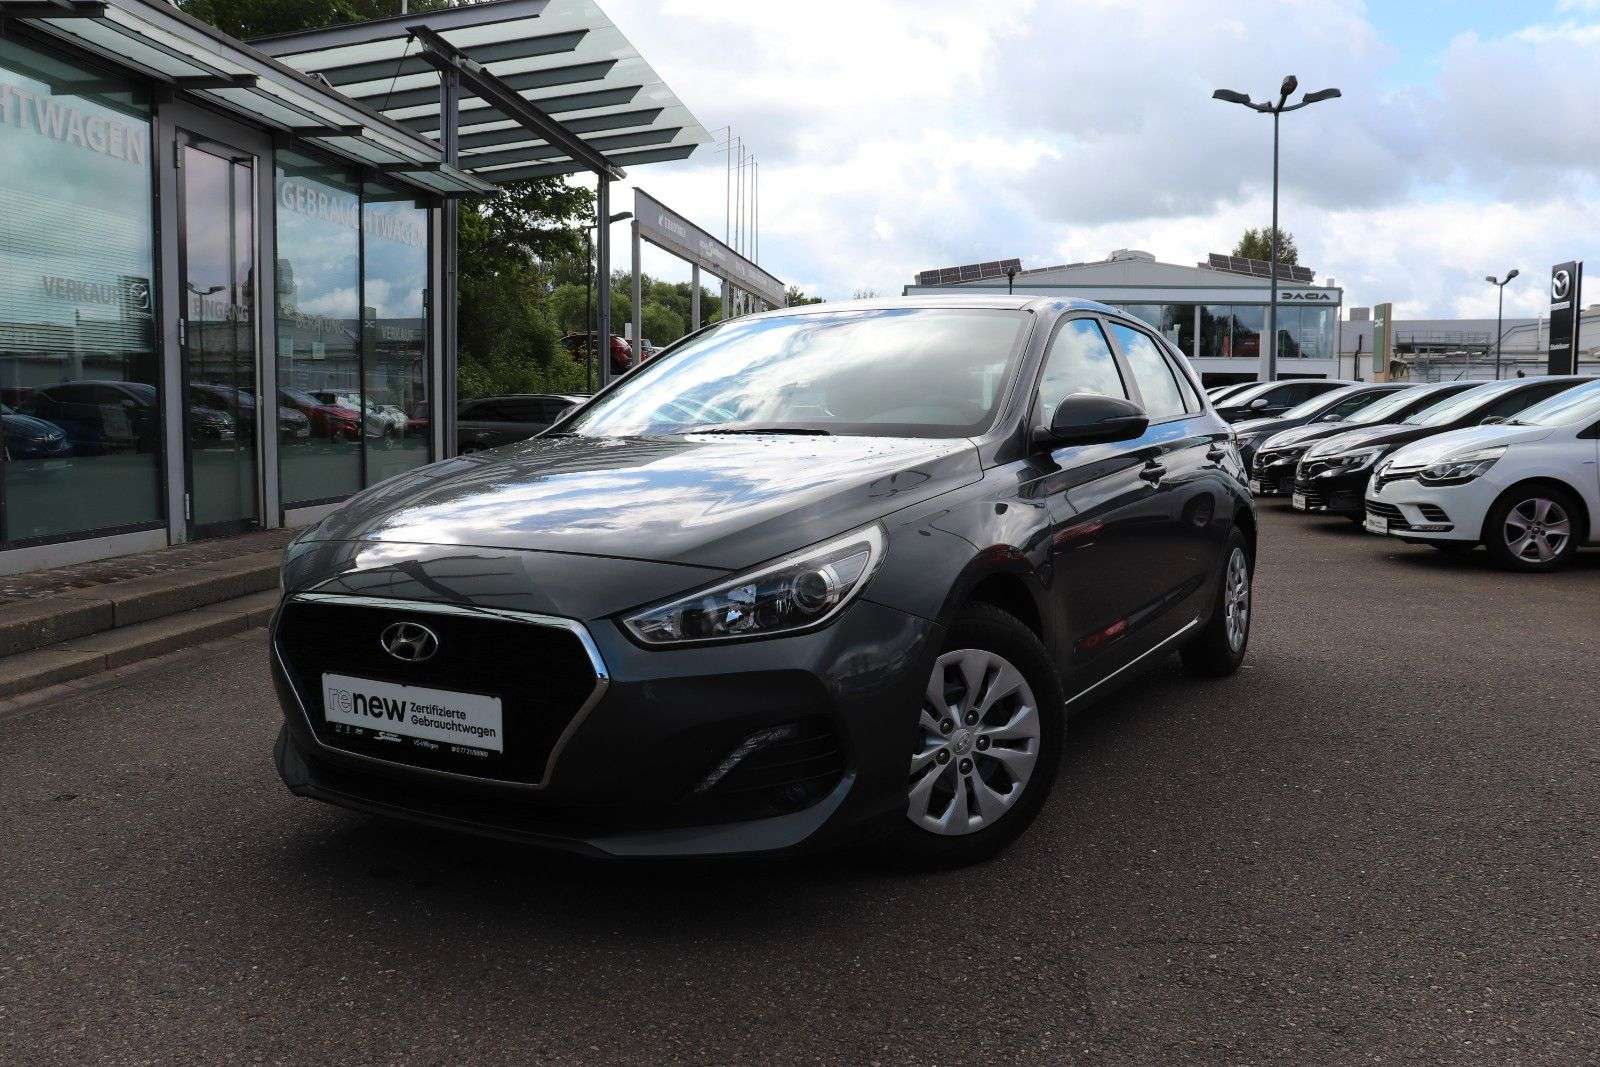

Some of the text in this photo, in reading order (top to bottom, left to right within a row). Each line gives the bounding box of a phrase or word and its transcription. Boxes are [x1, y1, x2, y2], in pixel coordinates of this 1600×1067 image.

[1281, 292, 1331, 300] DACIA
[328, 687, 467, 723] renew Zertifizierte
[411, 715, 497, 738] Gebrauchtwagen
